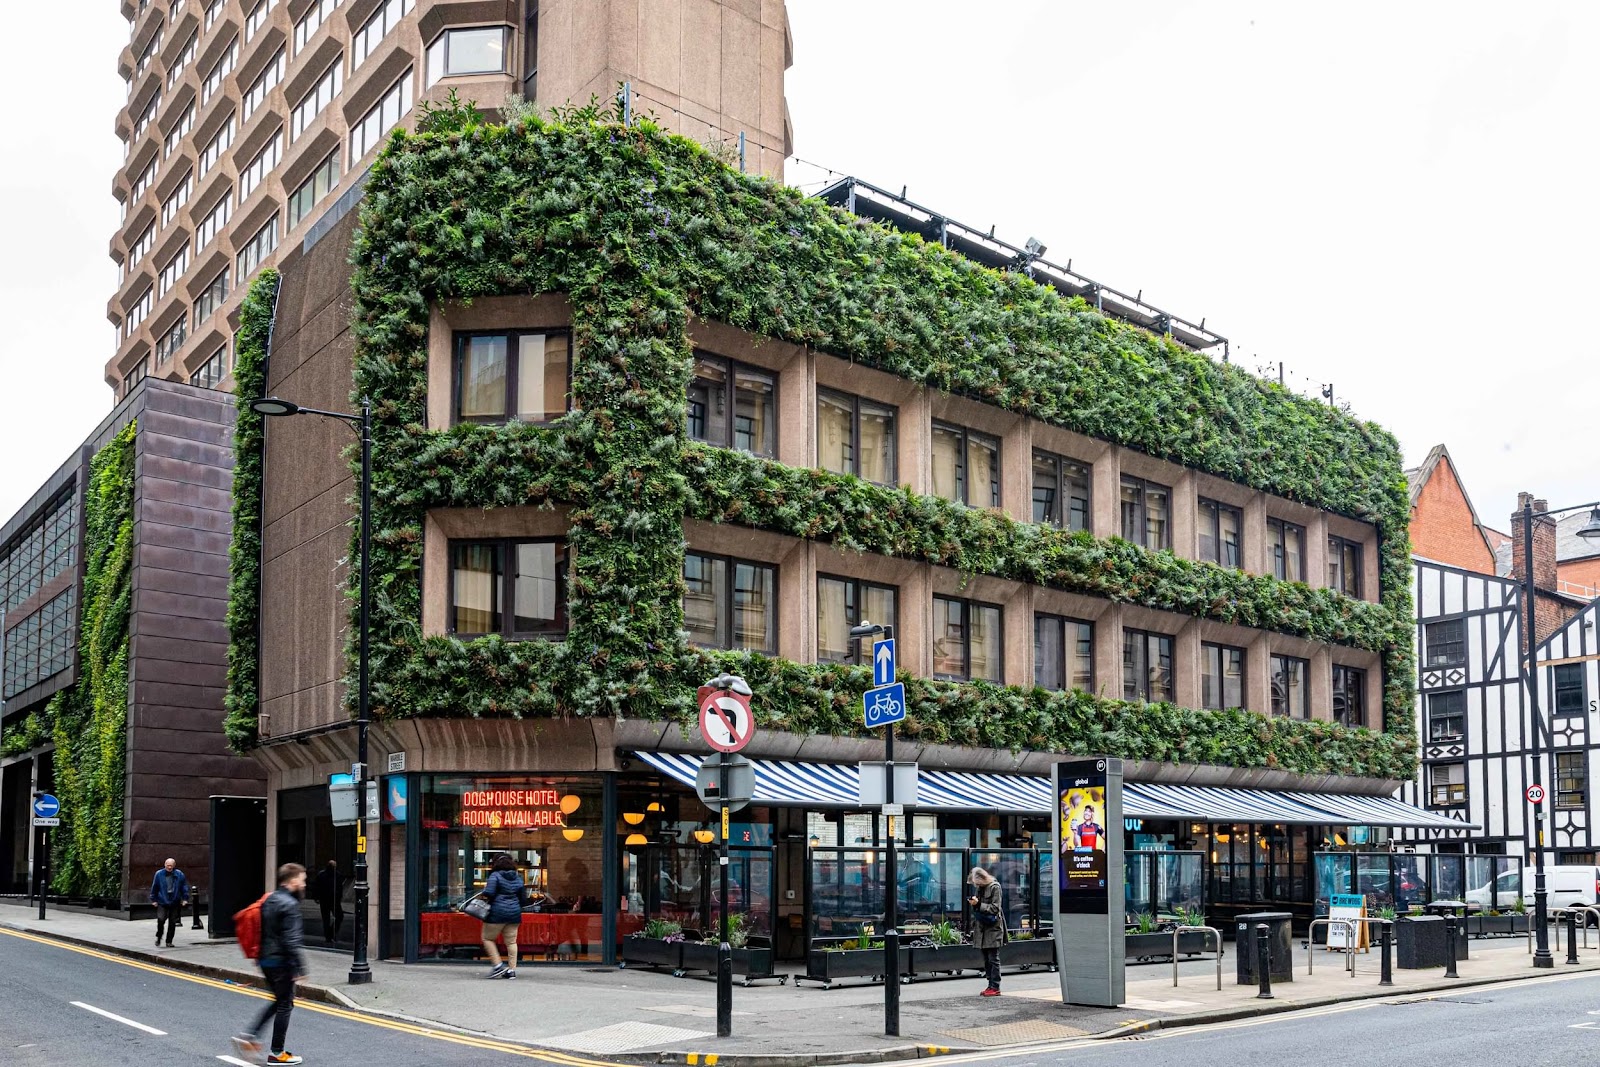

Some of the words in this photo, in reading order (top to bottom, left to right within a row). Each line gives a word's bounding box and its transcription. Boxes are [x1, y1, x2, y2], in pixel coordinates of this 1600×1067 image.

[390, 761, 403, 771] STREET
[1075, 777, 1089, 787] global
[463, 791, 524, 807] DOGHOUSE
[525, 790, 560, 806] HOTEL
[1529, 790, 1542, 798] 20
[463, 811, 502, 826] ROOMS
[504, 811, 562, 826] AVAILABLE
